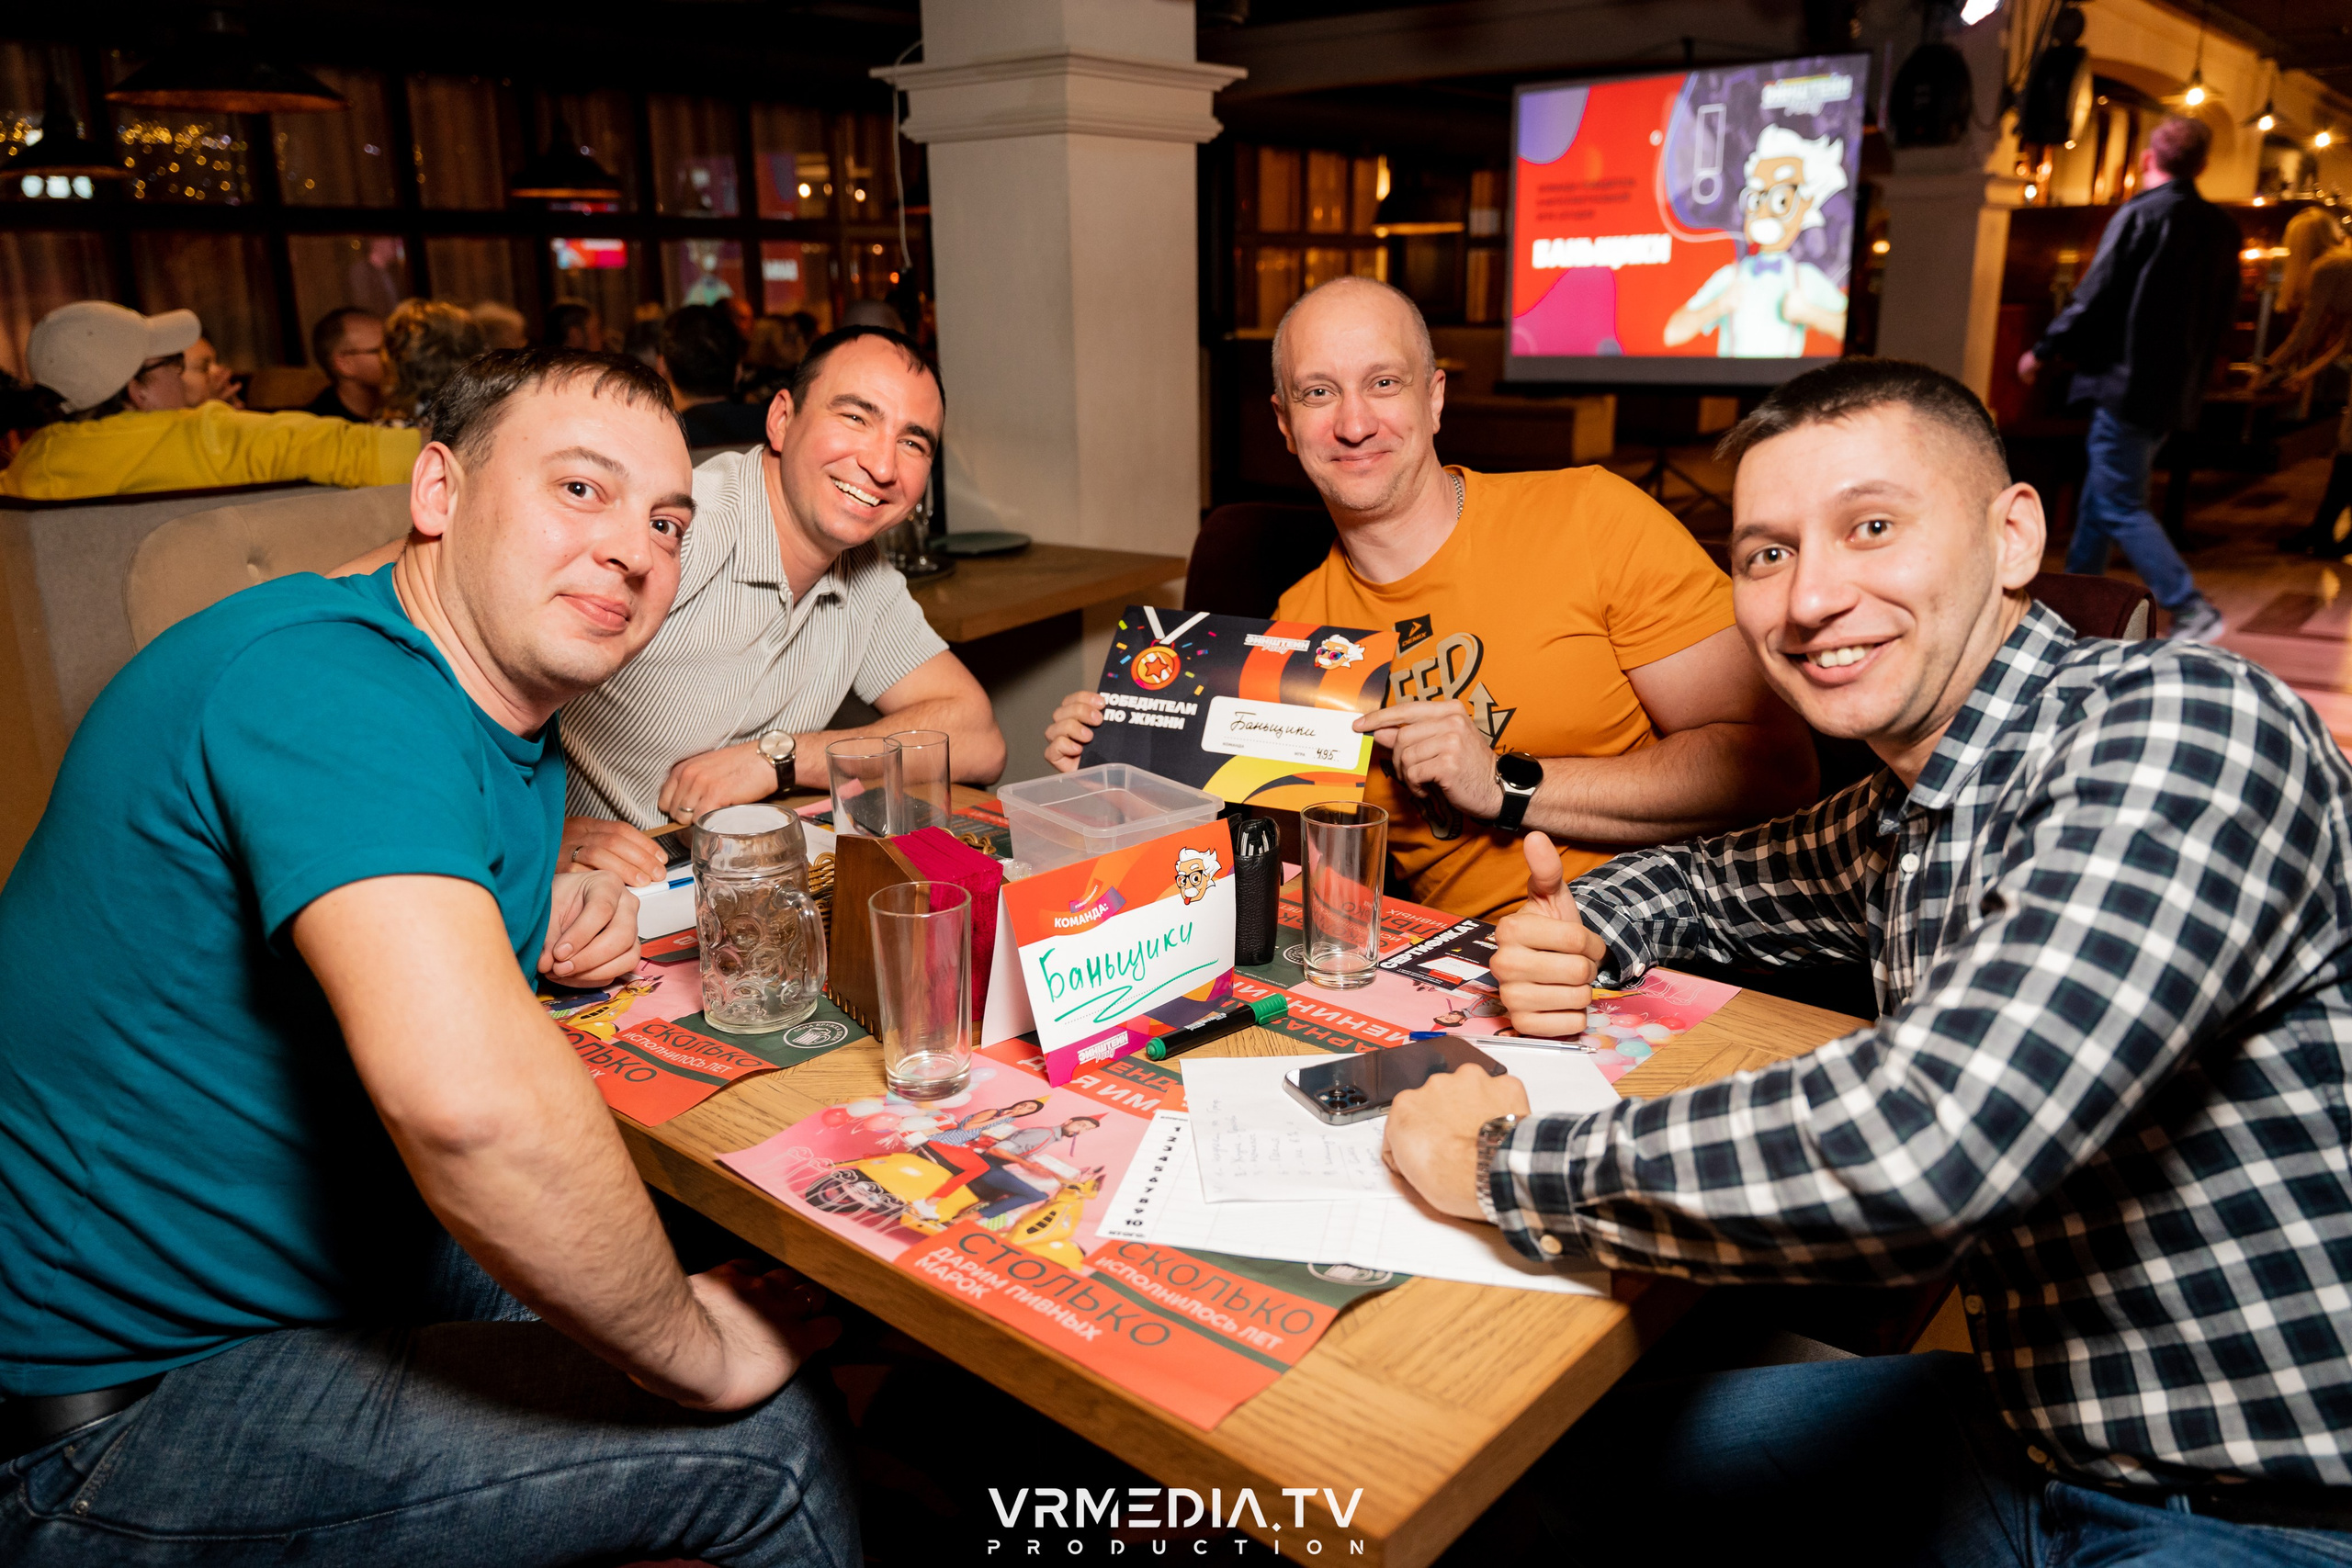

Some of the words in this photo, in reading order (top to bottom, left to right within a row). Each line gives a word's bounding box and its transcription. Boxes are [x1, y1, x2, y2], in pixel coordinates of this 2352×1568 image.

[1402, 631, 1427, 647] DEMIX
[1103, 708, 1126, 723] ПО
[1128, 711, 1186, 730] ЖИЗНИ
[1230, 711, 1317, 739] Баньщики
[1317, 748, 1339, 761] 495
[1054, 903, 1109, 930] КОМАНДА:
[559, 1025, 657, 1083] ОЛЬКО
[622, 1031, 706, 1068] ИСПОЛНИЛОСЬ
[704, 1062, 733, 1075] ЛЕТ
[641, 1023, 763, 1067] СКОЛЬКО
[914, 1255, 992, 1300] МАРОК
[929, 1247, 1009, 1290] ДАРИМ
[1004, 1284, 1102, 1342] ПИВНЫХ
[958, 1232, 1171, 1347] СТОЛЬКО
[1117, 1241, 1315, 1335] СКОЛЬКО
[1094, 1256, 1238, 1333] ИСПОЛНИЛОСЬ
[1237, 1325, 1284, 1351] ЛЕТ
